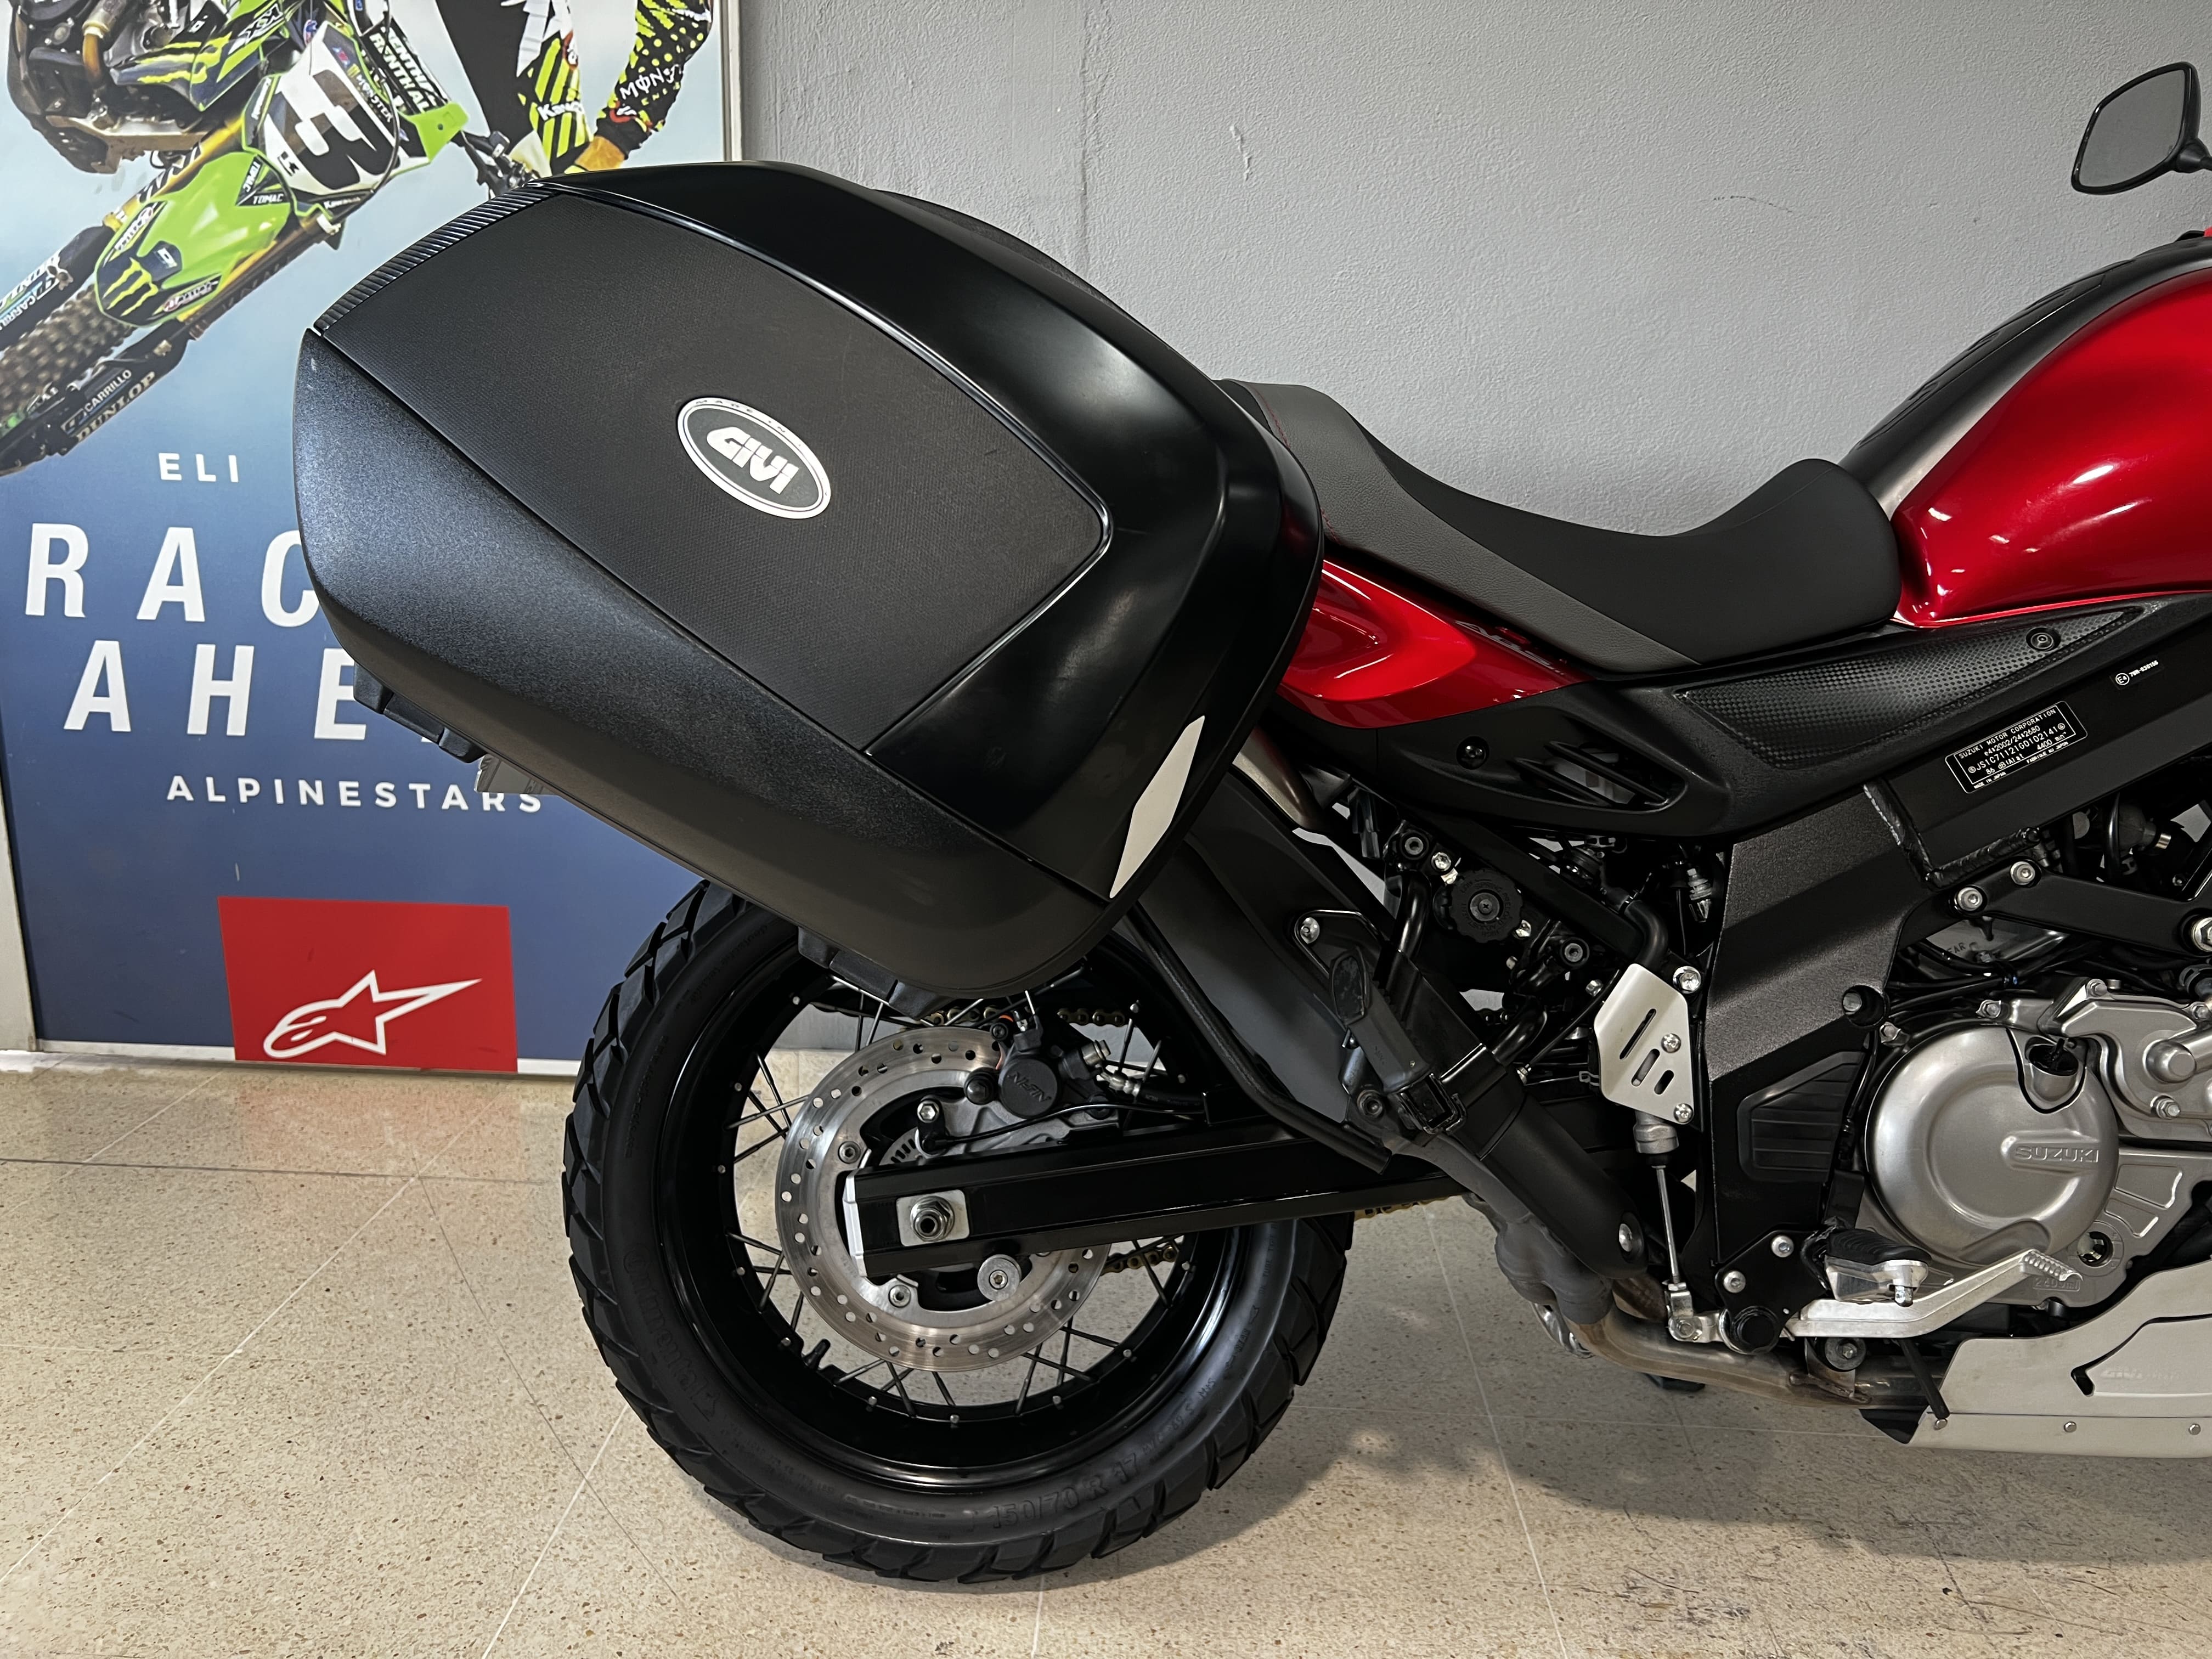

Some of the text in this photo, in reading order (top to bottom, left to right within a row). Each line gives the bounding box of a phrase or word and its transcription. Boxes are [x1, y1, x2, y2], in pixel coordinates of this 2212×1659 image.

[253, 193, 284, 205] TOMAC
[77, 371, 155, 441] DUNLOP
[84, 369, 132, 412] CARRILLO
[159, 453, 239, 483] ELI
[707, 427, 799, 494] GIVI
[64, 640, 366, 740] AHE
[1959, 709, 2056, 759] SUZUKI MOTOR CORPORATION
[2015, 1146, 2099, 1163] SUZUKI
